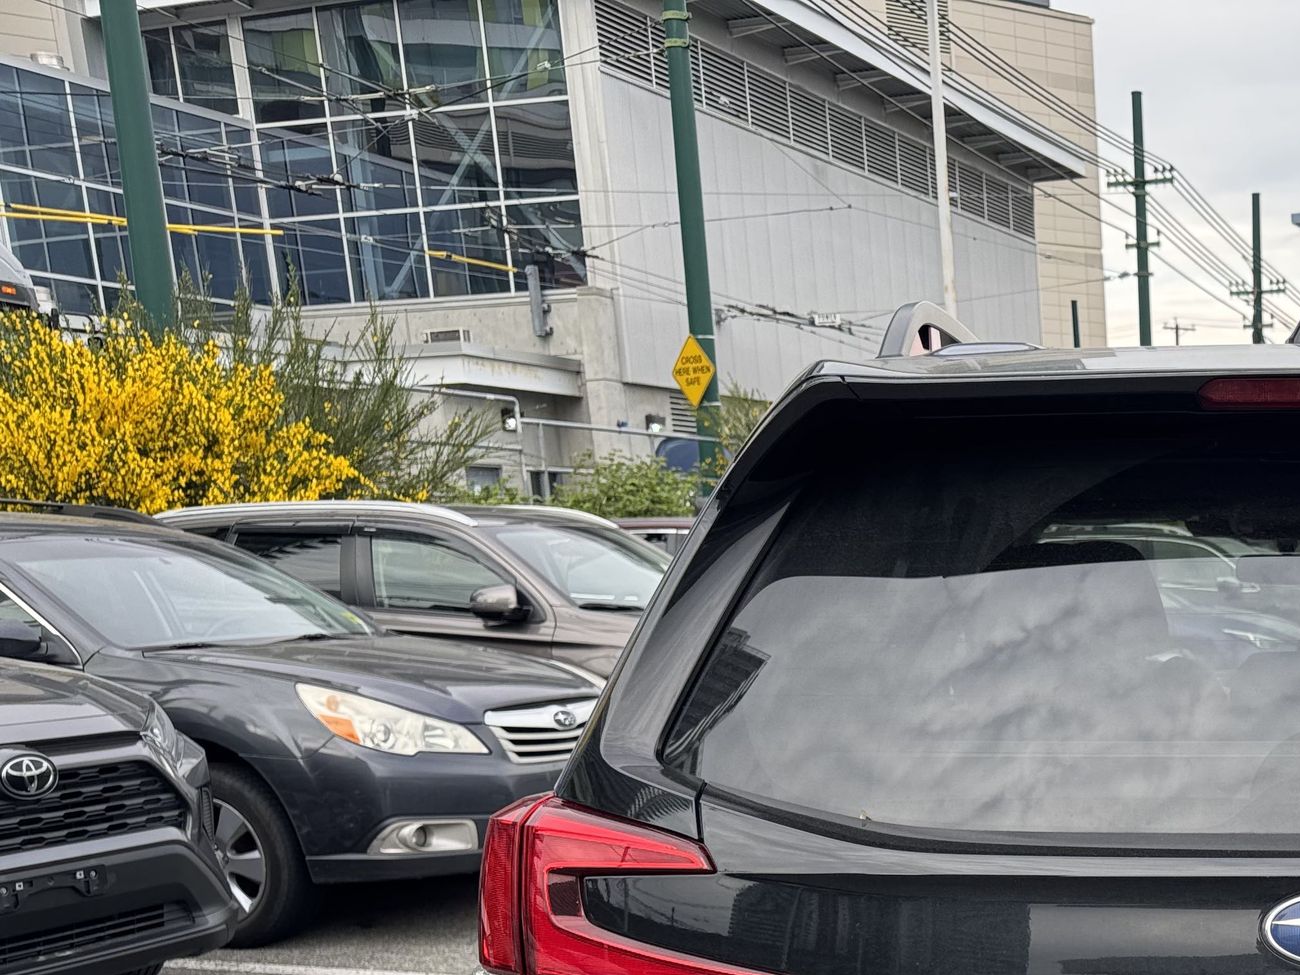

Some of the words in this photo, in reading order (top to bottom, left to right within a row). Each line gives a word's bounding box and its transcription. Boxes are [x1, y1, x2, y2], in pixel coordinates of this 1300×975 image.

[681, 355, 703, 366] CROSS
[675, 366, 691, 377] HERE
[692, 364, 712, 375] WHEN
[685, 376, 701, 387] SAFE
